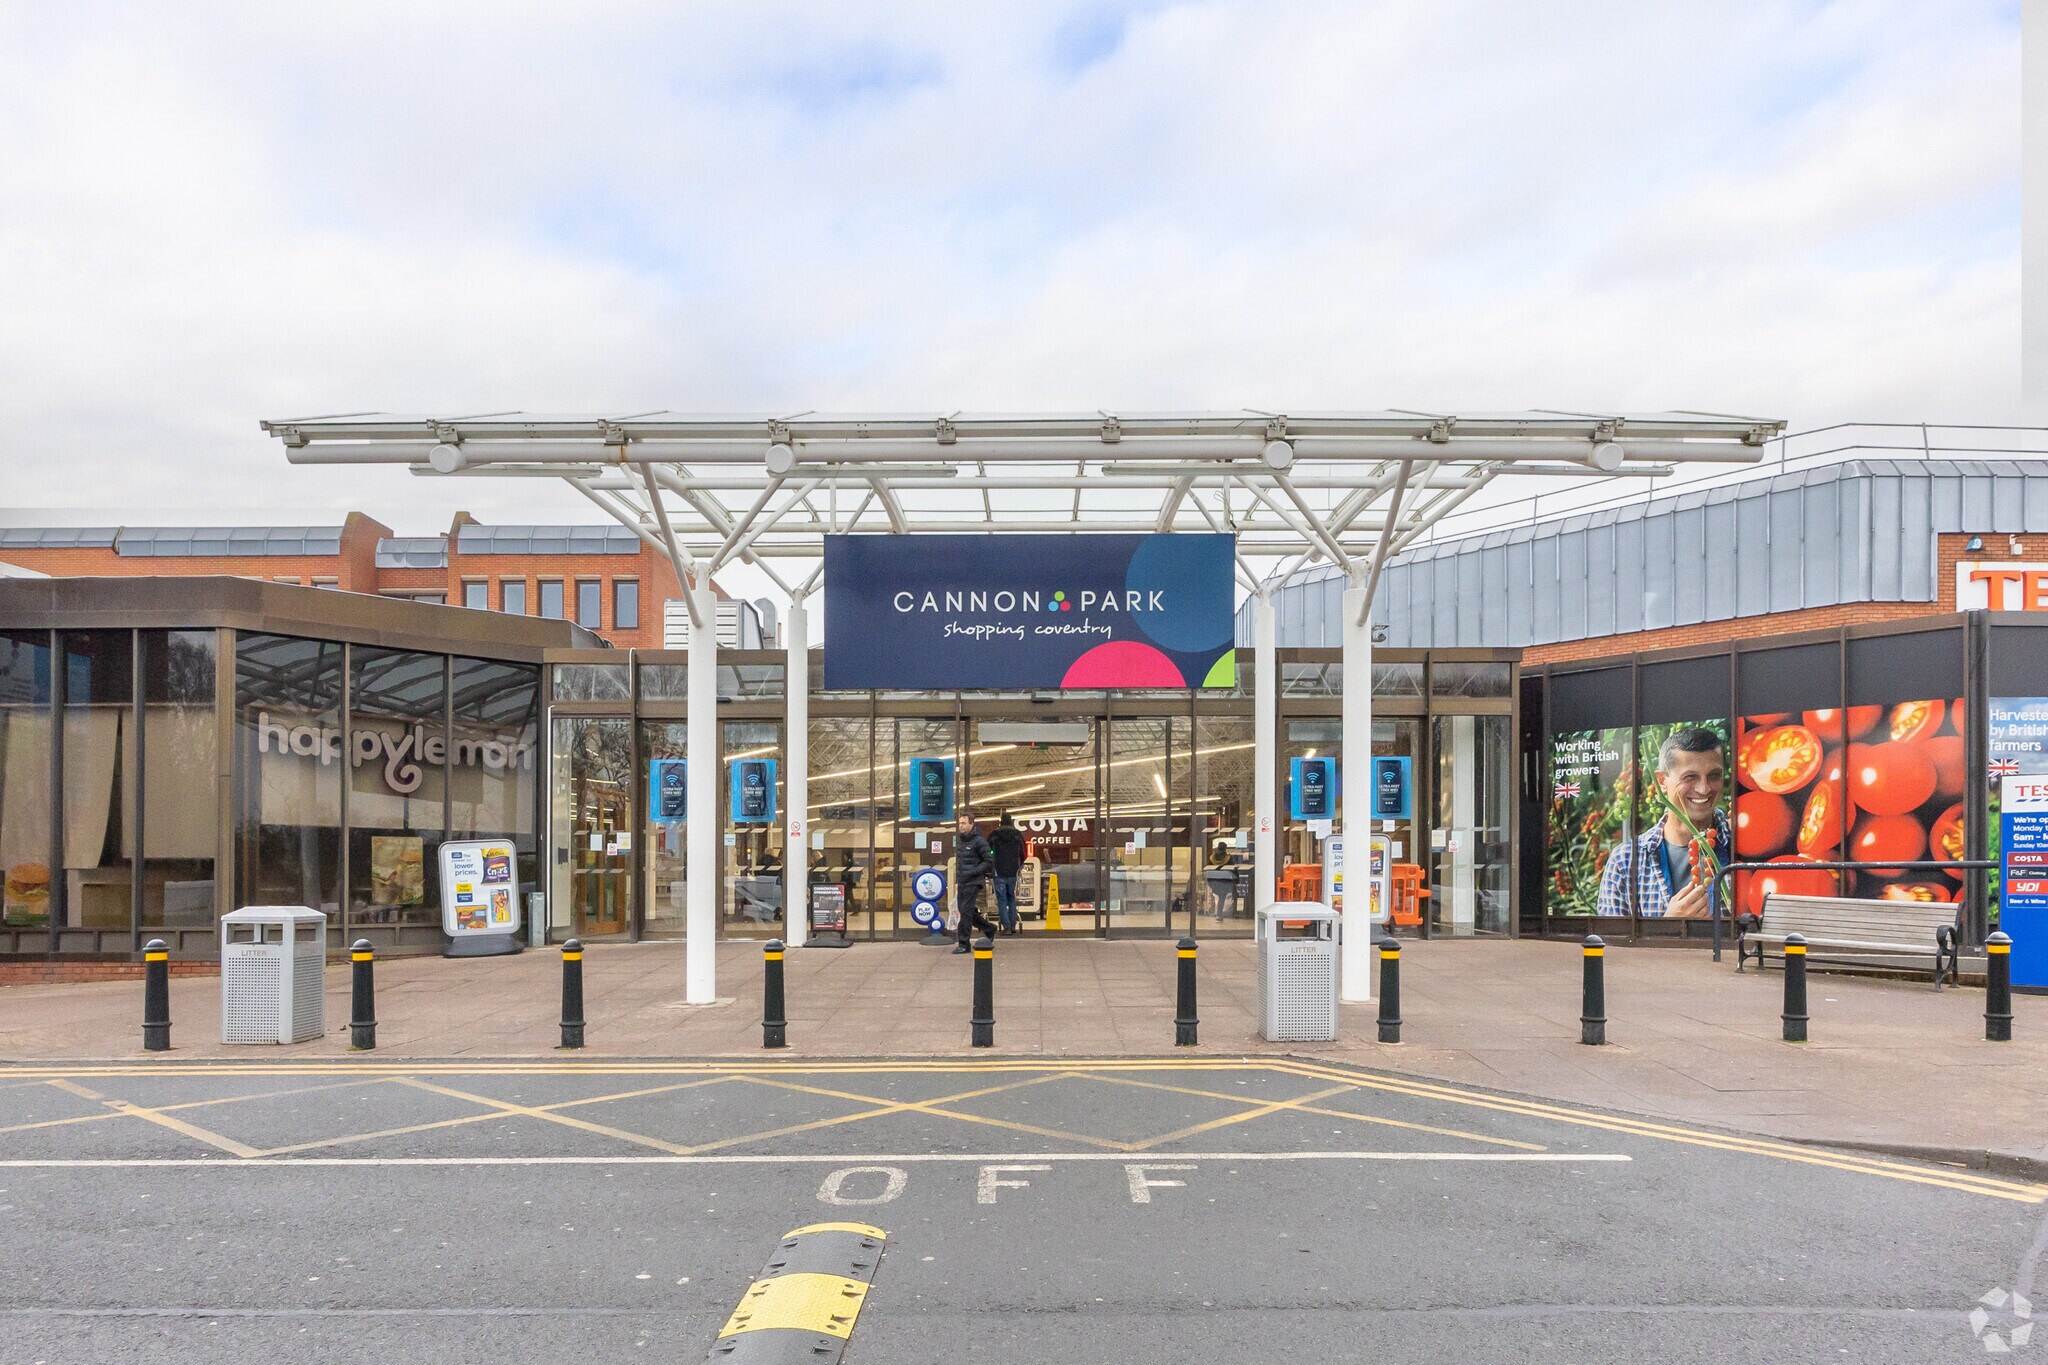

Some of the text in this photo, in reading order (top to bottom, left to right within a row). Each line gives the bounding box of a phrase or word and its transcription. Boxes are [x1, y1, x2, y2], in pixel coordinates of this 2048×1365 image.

[894, 590, 1164, 612] CANNON PARK
[944, 618, 1112, 640] shopping coventry
[1990, 723, 2005, 738] by
[1555, 740, 1601, 751] Working
[1989, 739, 2041, 751] farmers
[1555, 750, 1619, 765] with British
[1555, 766, 1600, 779] growers
[1013, 818, 1088, 834] COSTA
[455, 869, 478, 877] prices.
